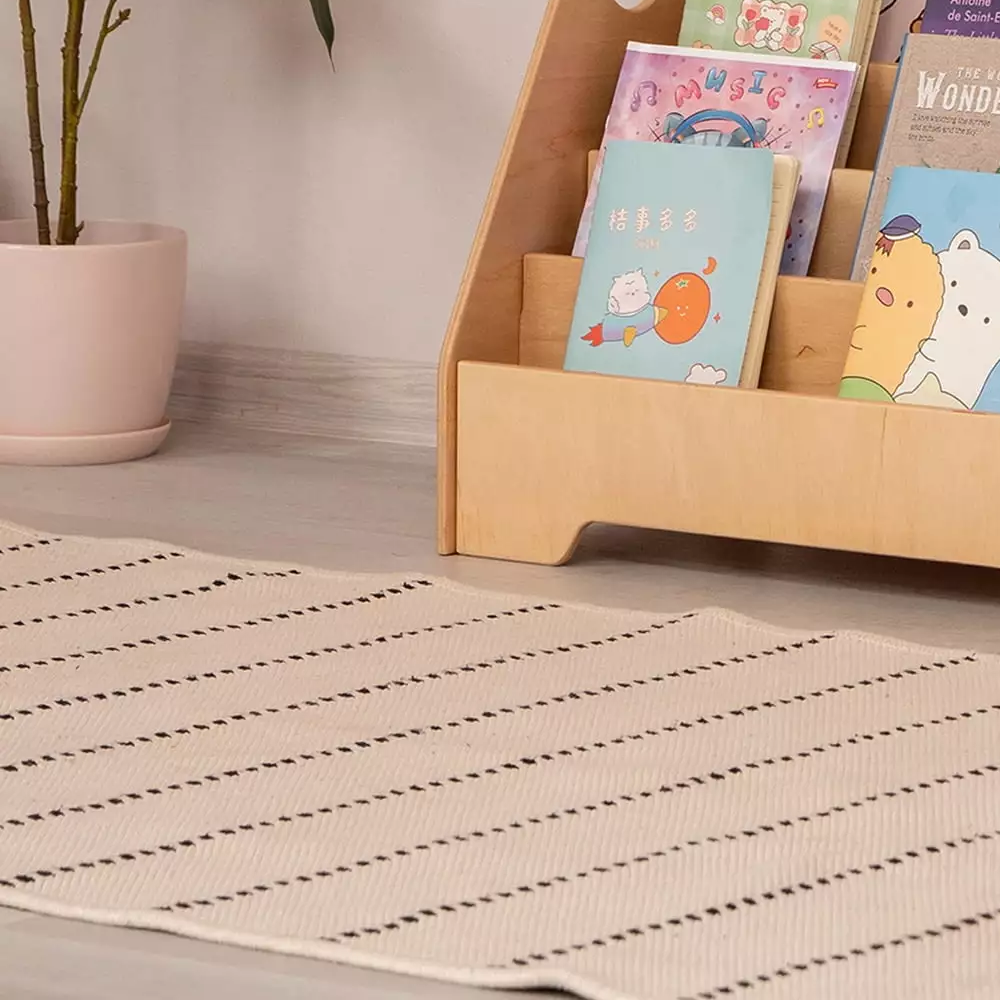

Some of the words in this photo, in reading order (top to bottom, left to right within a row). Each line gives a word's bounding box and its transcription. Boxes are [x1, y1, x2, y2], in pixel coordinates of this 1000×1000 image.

[947, 10, 961, 22] de
[943, 28, 963, 37] Th
[957, 66, 981, 81] THE
[674, 66, 787, 110] MUSIC
